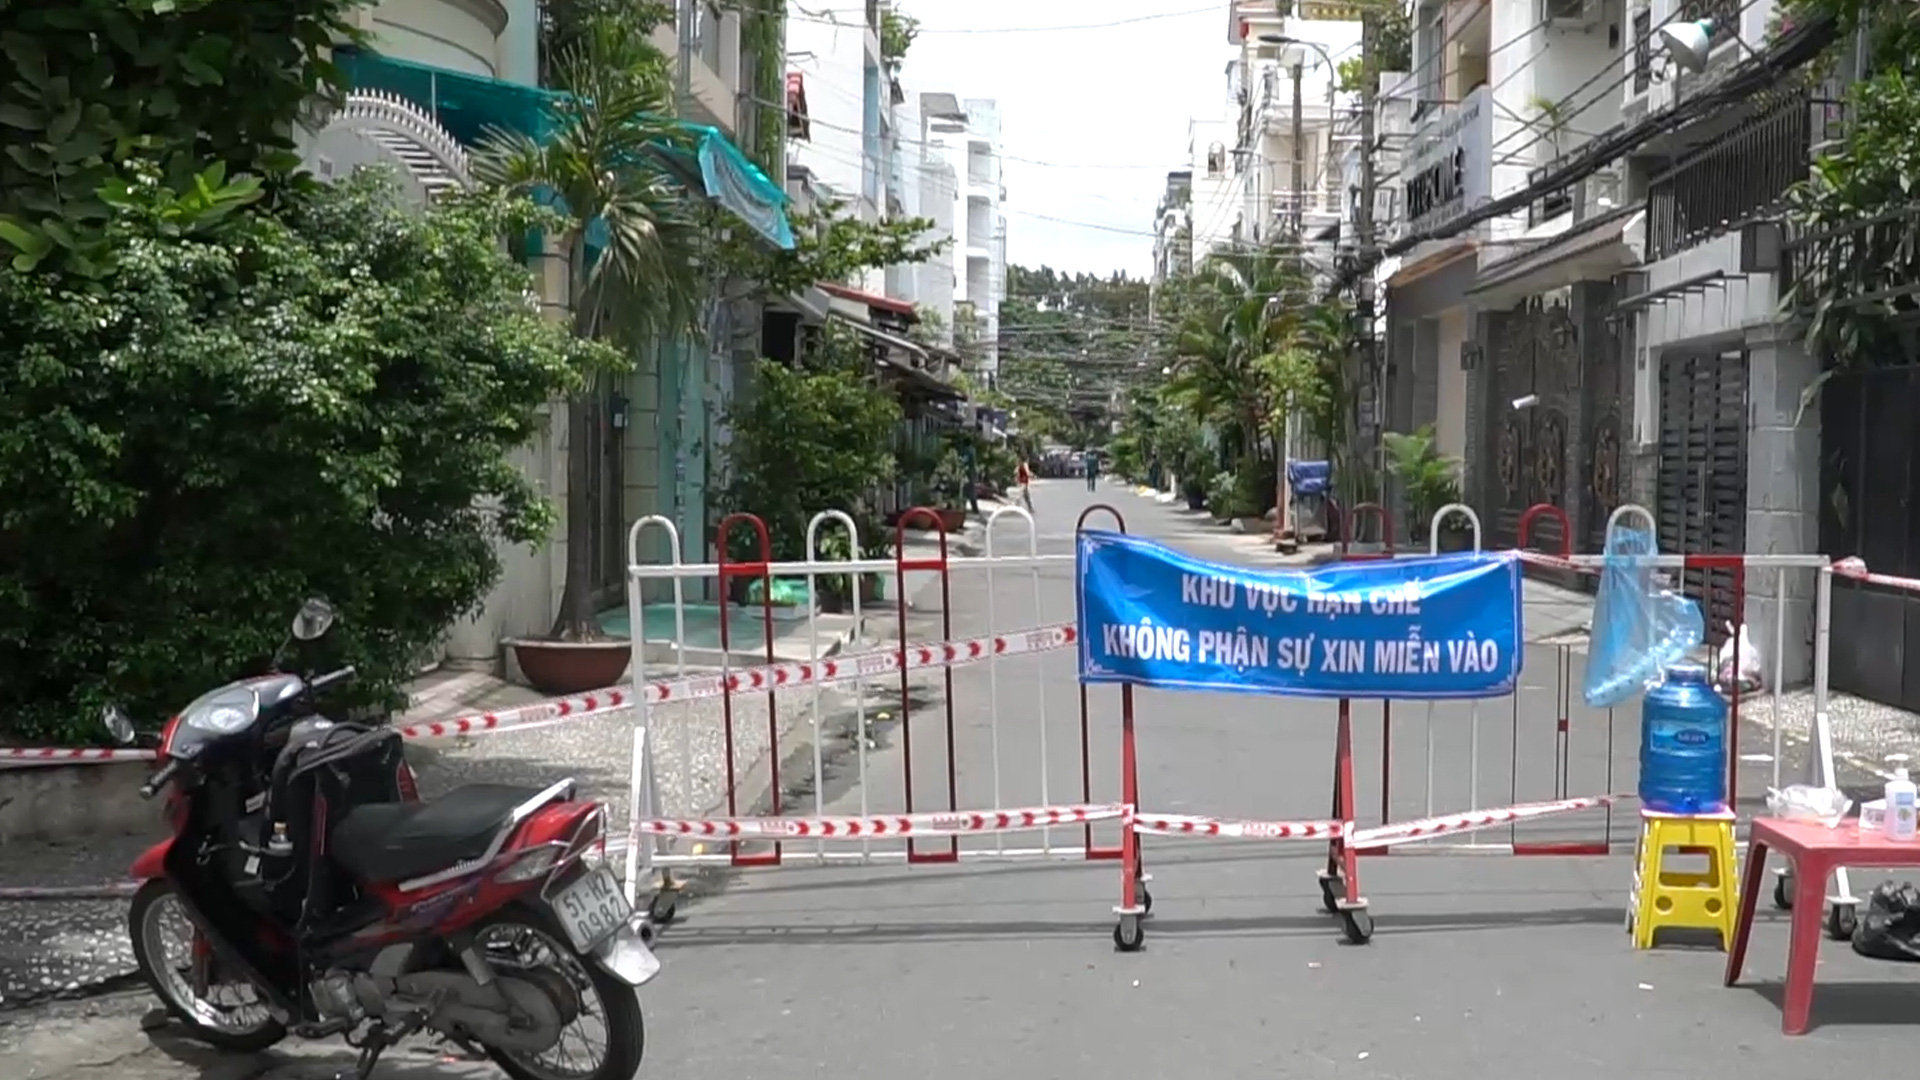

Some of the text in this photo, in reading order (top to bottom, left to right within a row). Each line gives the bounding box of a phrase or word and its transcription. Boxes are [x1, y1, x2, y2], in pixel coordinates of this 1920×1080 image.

[1182, 573, 1236, 609] KHU
[1102, 616, 1190, 663] KHÔNG
[1198, 626, 1269, 672] PHẬN
[1277, 632, 1315, 676] SỰ
[1320, 639, 1366, 674] XIN
[1373, 624, 1440, 674] MIỄN
[1447, 630, 1498, 673] VÀO
[577, 895, 624, 942] 0982
